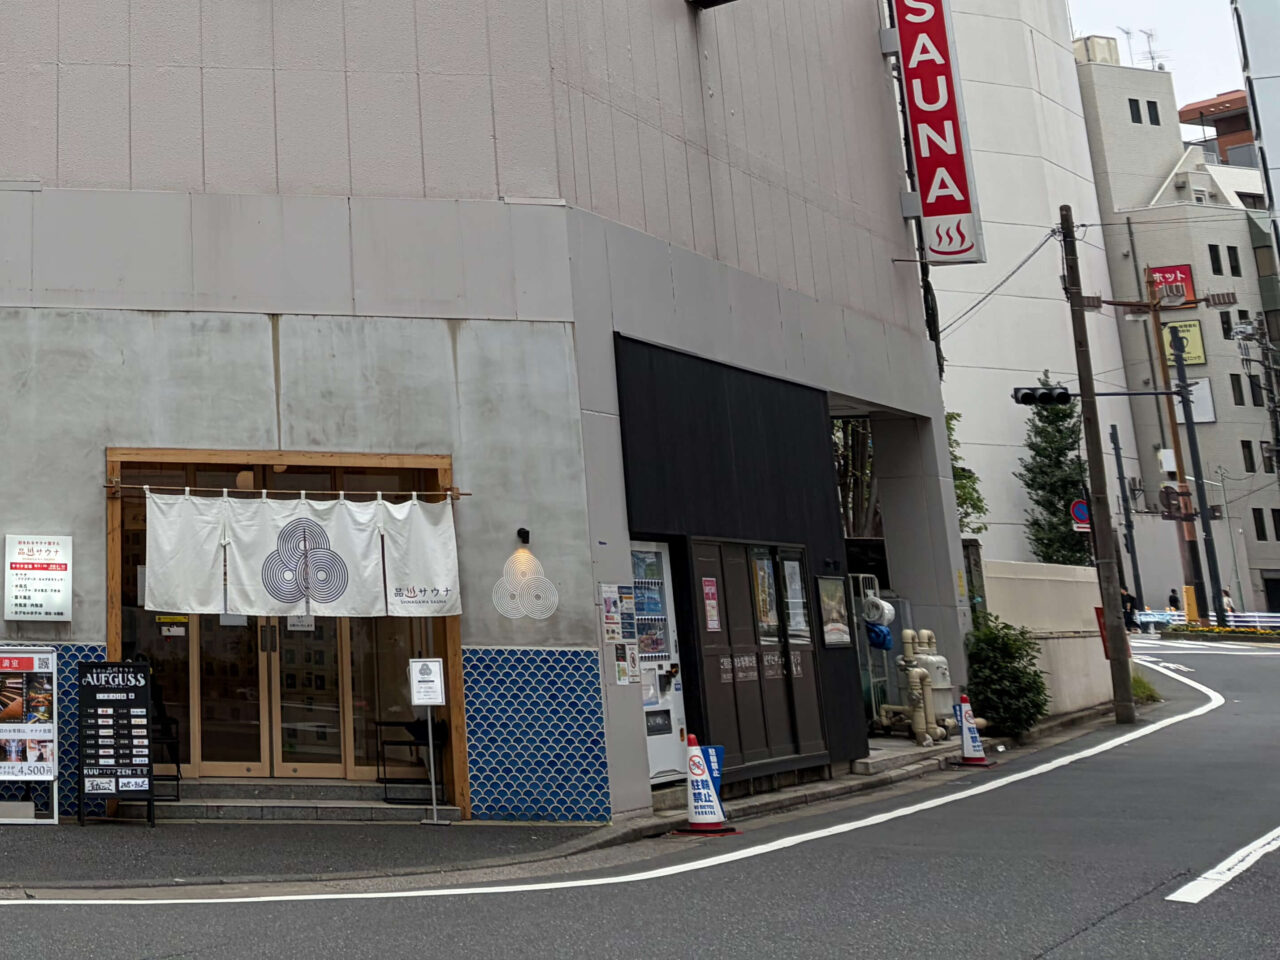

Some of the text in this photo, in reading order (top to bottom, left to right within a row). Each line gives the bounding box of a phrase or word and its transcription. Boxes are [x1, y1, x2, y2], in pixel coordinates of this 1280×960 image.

[1153, 270, 1186, 282] ホット
[82, 673, 146, 686] AUFGUSS
[693, 791, 713, 803] 禁止
